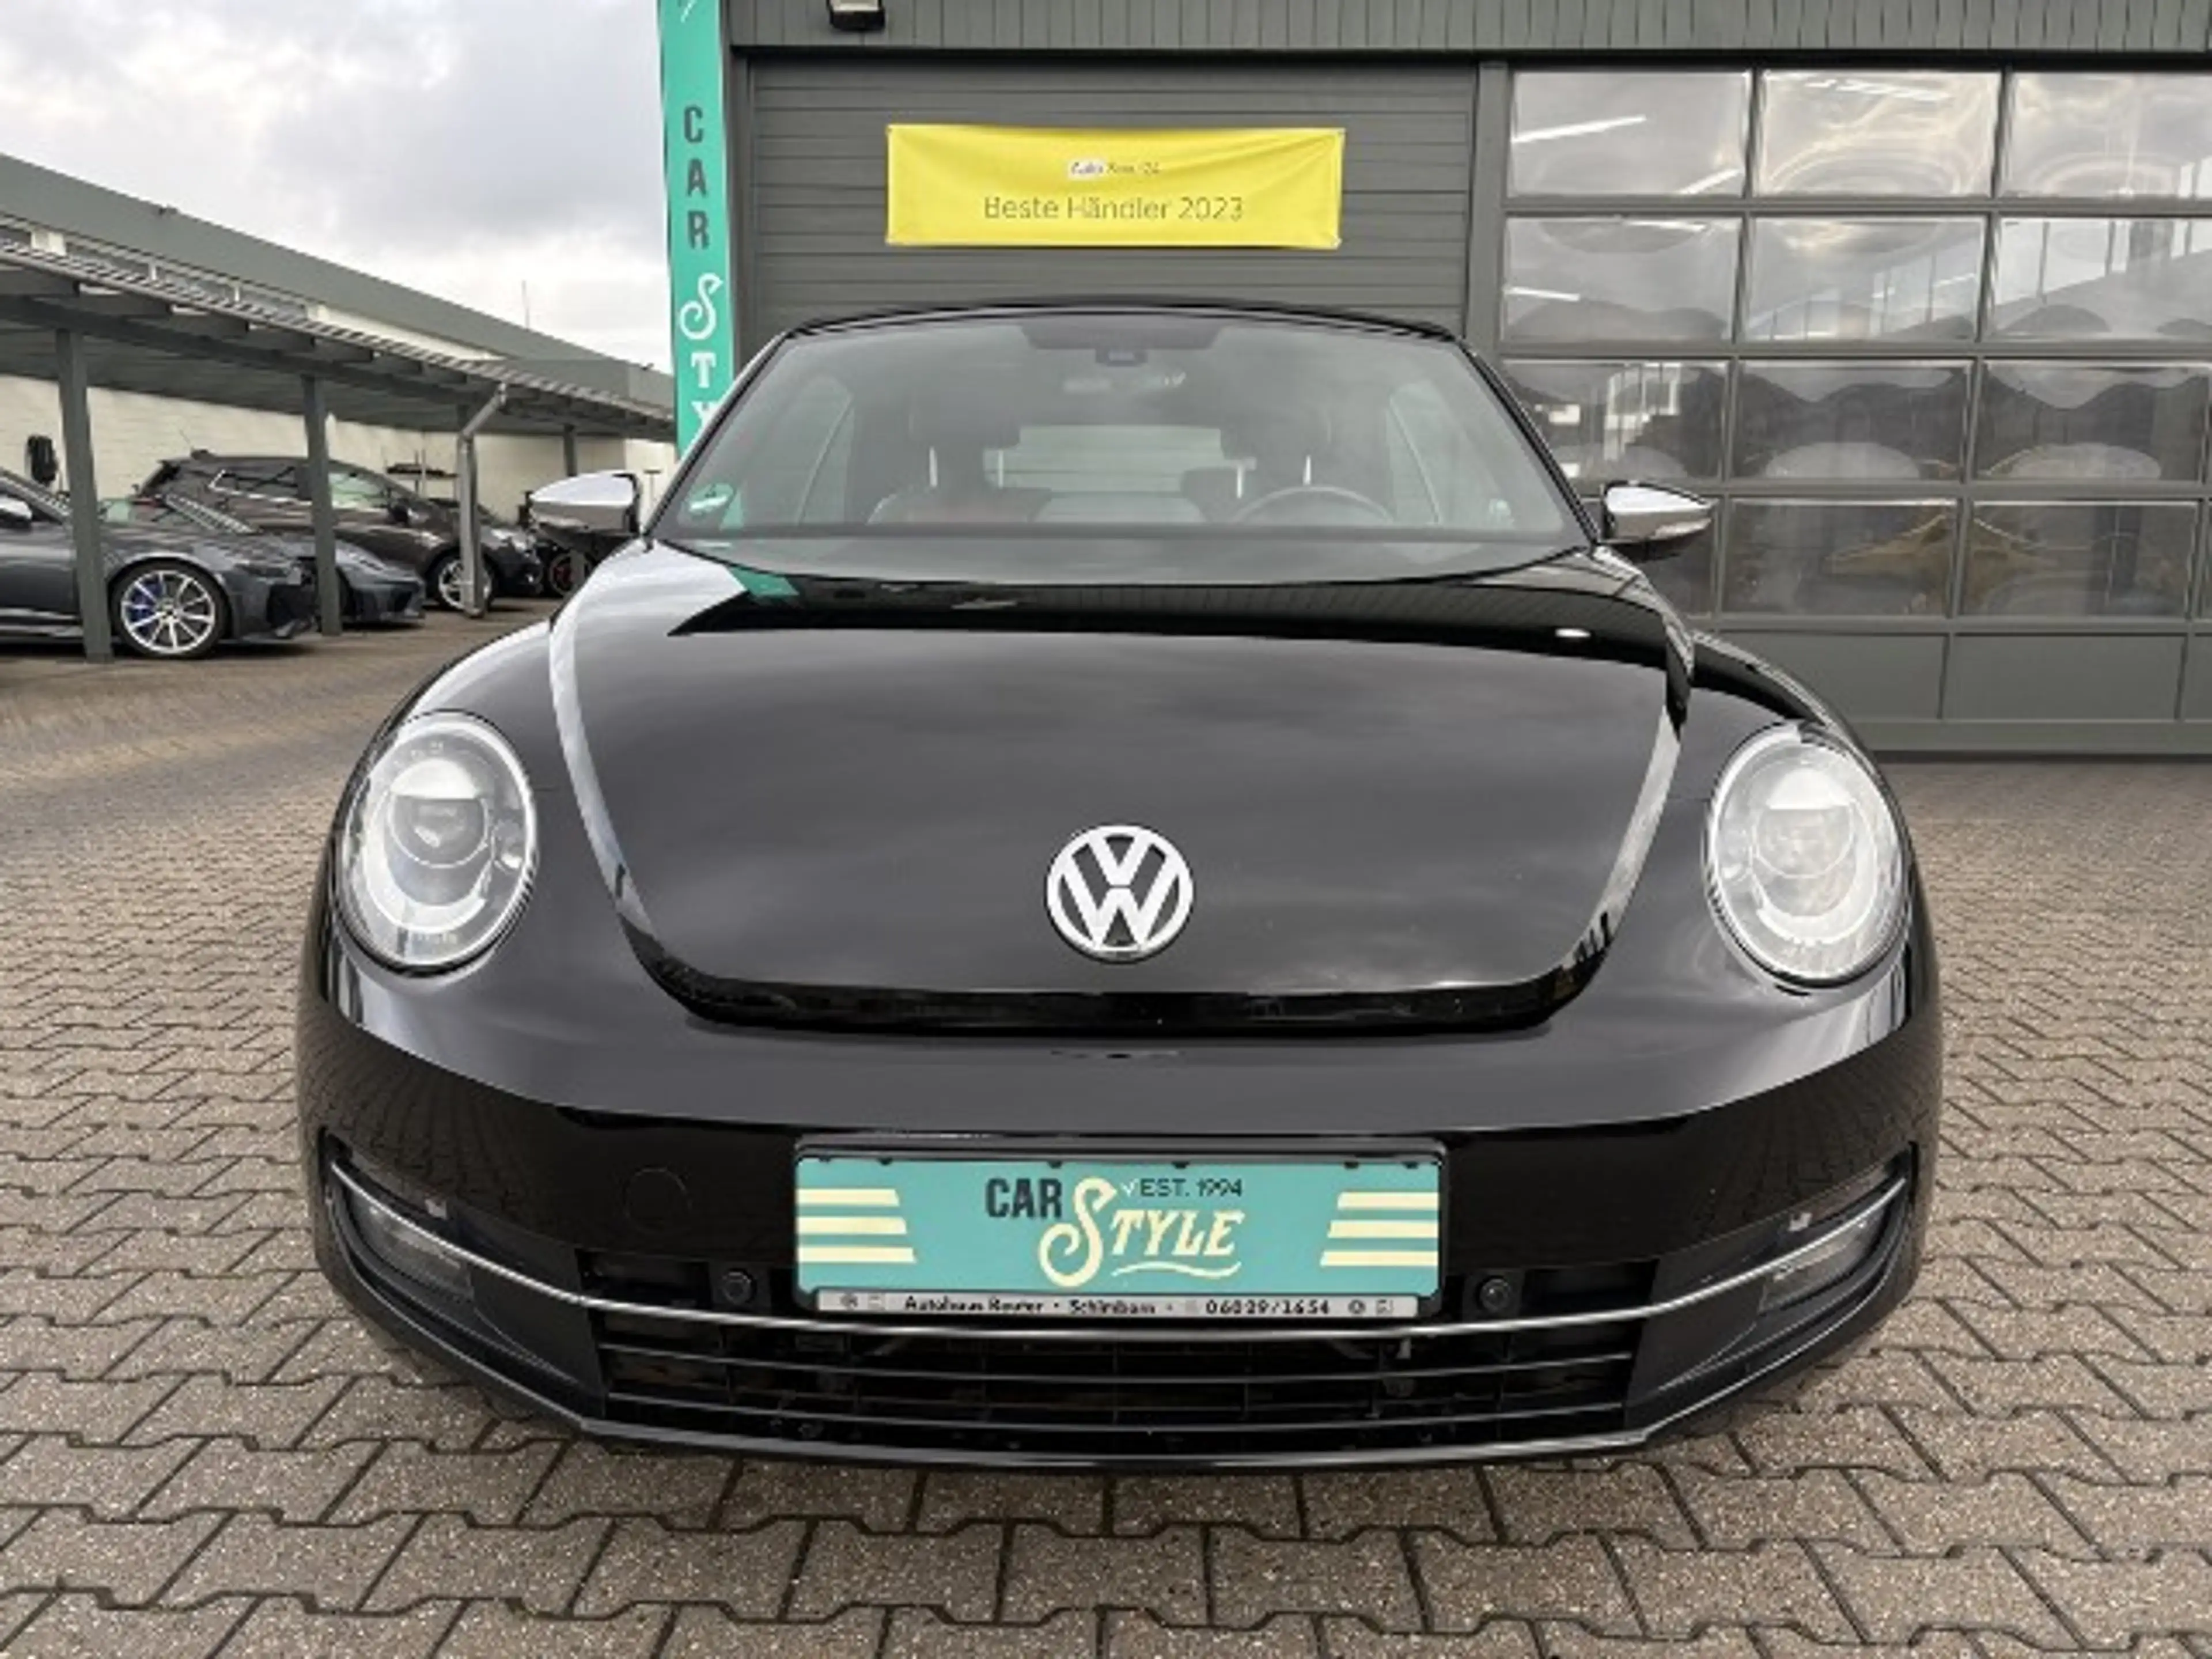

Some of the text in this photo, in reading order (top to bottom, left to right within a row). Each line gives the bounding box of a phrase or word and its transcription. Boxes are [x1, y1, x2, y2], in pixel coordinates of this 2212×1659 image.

[684, 105, 710, 250] CAR
[984, 196, 1243, 221] Beste Händler 2023
[1048, 825, 1191, 953] VW
[986, 1177, 1245, 1287] CAR STYLE
[1140, 1178, 1243, 1197] EST. 1994
